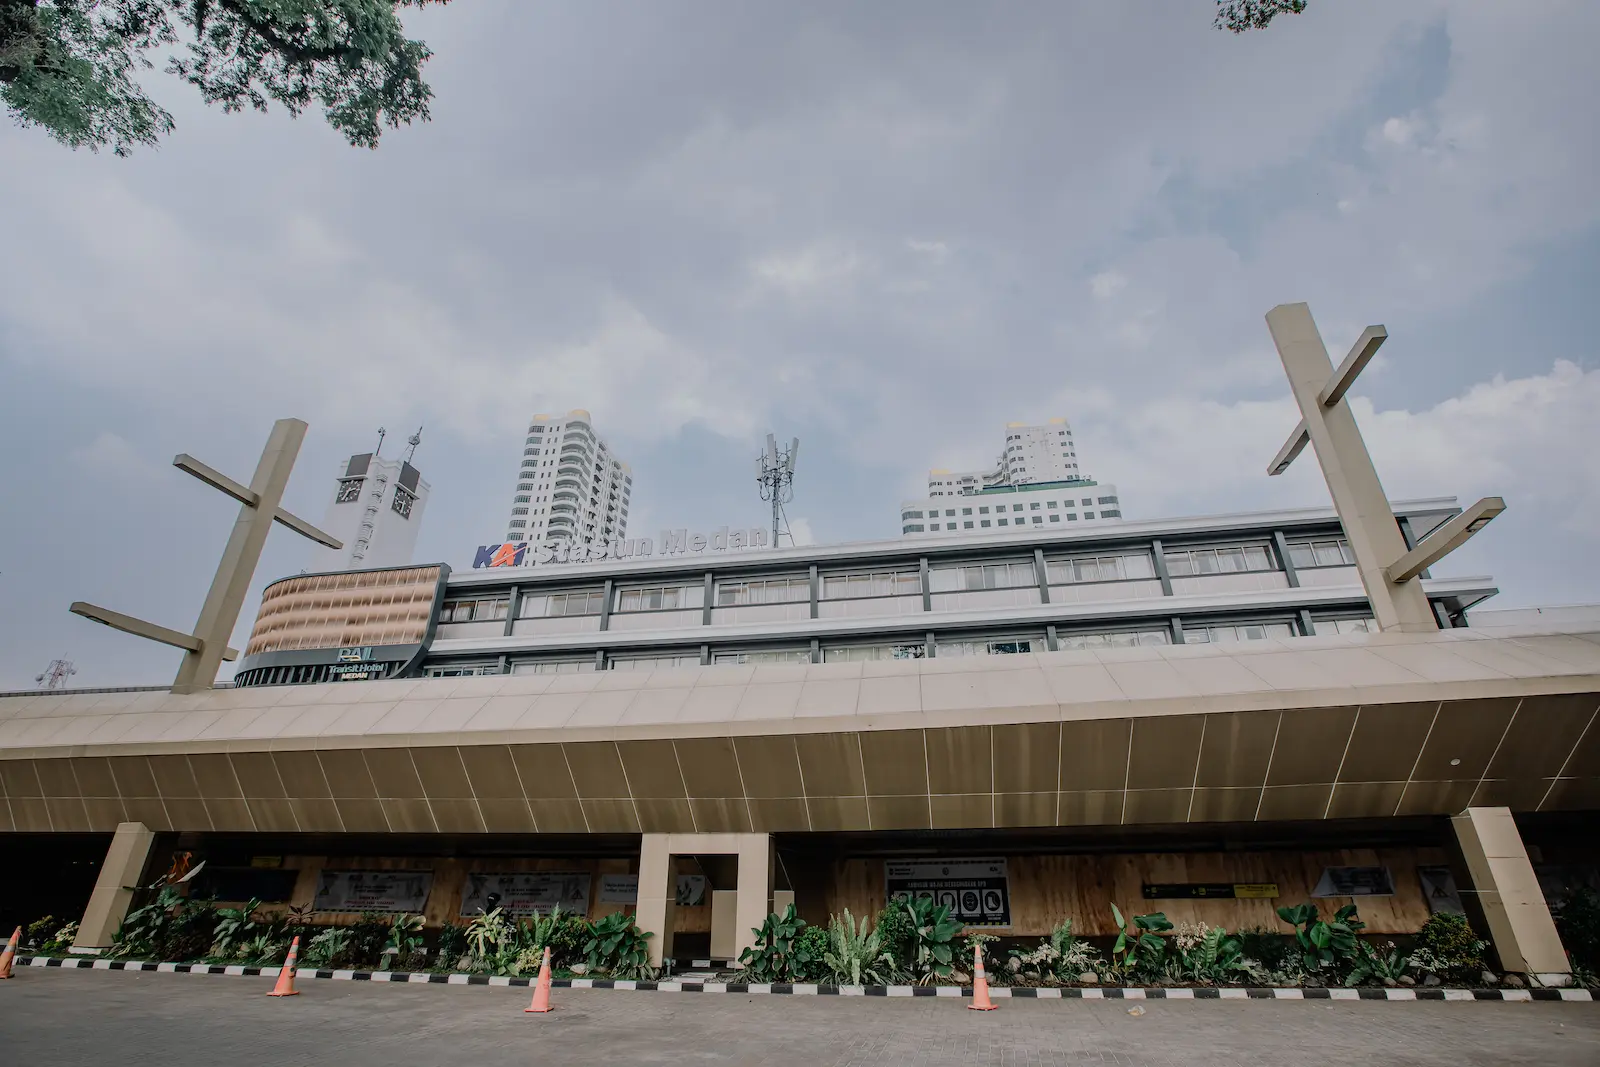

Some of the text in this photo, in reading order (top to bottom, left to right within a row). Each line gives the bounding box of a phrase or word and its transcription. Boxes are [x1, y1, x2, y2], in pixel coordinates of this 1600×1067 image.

[473, 525, 767, 568] KAI Stasiun Medan
[329, 662, 385, 673] Transit Hotel
